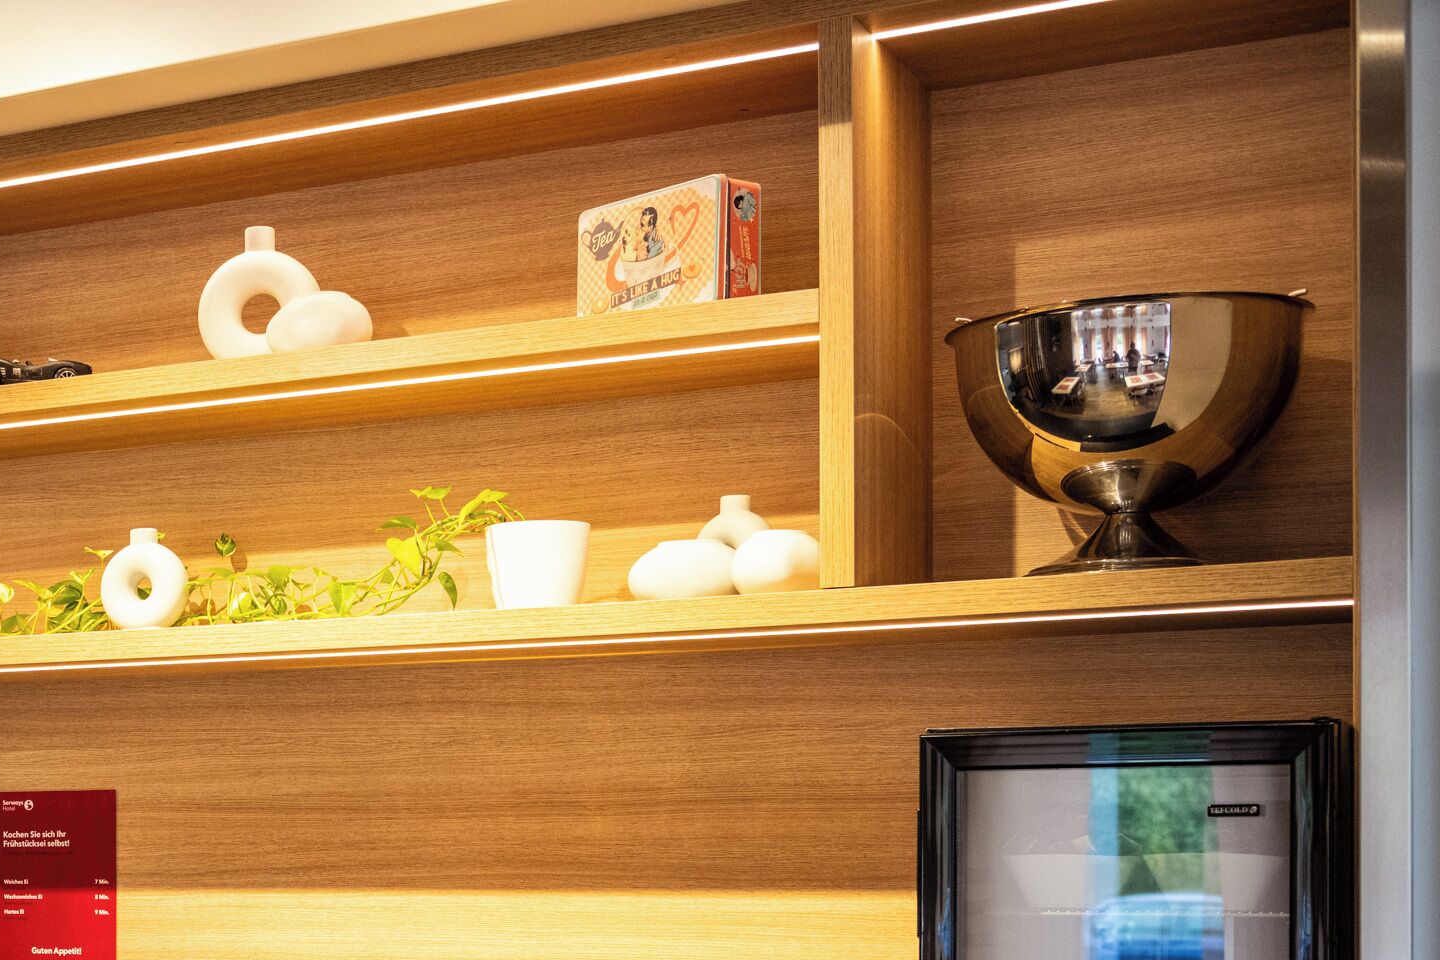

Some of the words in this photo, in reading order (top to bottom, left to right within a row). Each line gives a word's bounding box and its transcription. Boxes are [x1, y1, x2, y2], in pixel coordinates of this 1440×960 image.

[592, 229, 615, 252] Tea
[611, 289, 628, 307] IT'S
[630, 282, 648, 298] LIKE
[651, 279, 658, 290] A
[661, 269, 680, 286] HUG
[1209, 806, 1249, 814] TEFCOLD
[3, 831, 29, 839] Kochen
[42, 830, 55, 838] sich
[56, 830, 66, 838] Ihr
[3, 840, 46, 848] Frühstücksei
[31, 946, 52, 955] Guten
[53, 947, 82, 957] Appetit!
